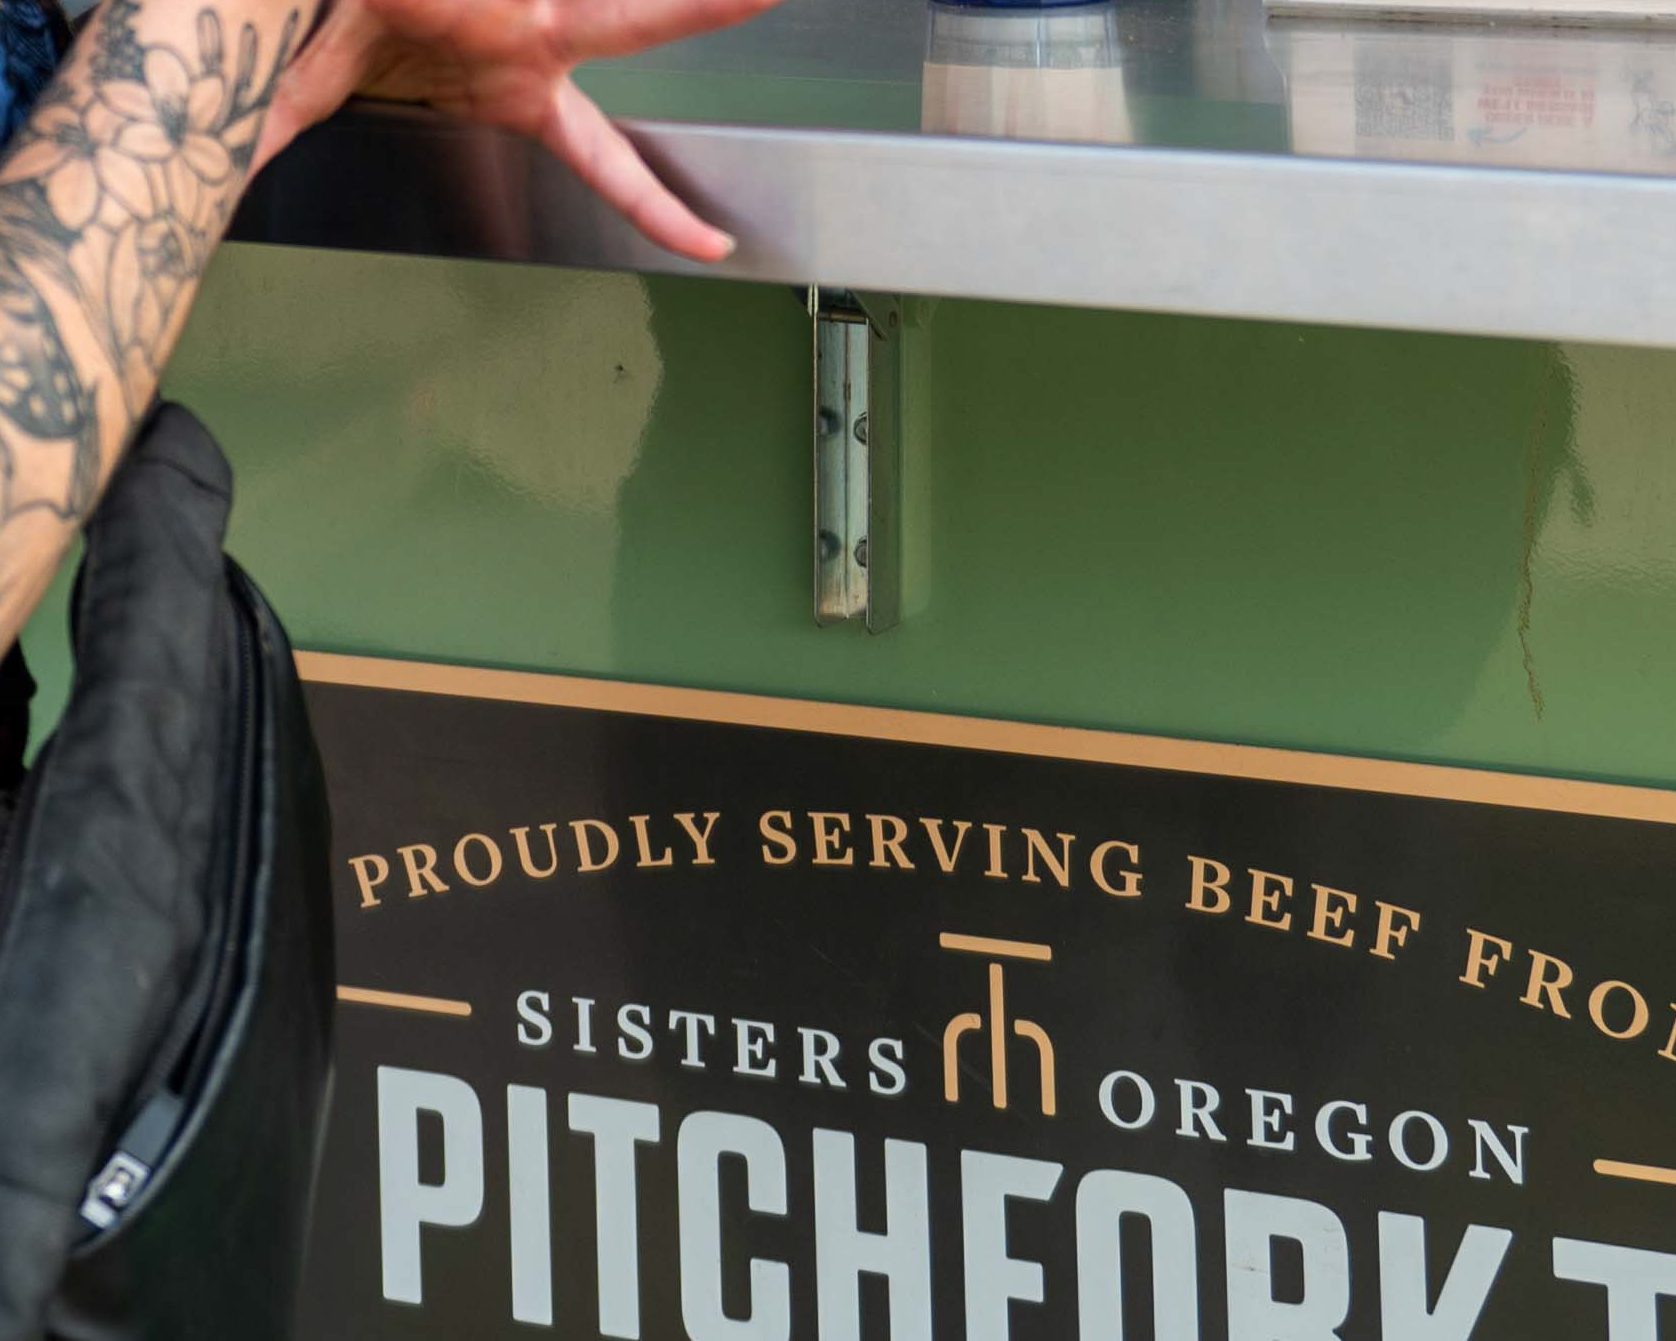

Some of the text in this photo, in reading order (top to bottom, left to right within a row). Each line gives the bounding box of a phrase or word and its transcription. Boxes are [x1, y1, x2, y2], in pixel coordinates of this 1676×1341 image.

[348, 811, 721, 908] PROUDLY
[758, 809, 1145, 897] SERVING
[1185, 854, 1421, 961] BEEF
[516, 989, 1529, 1185] SISTERS OREGON
